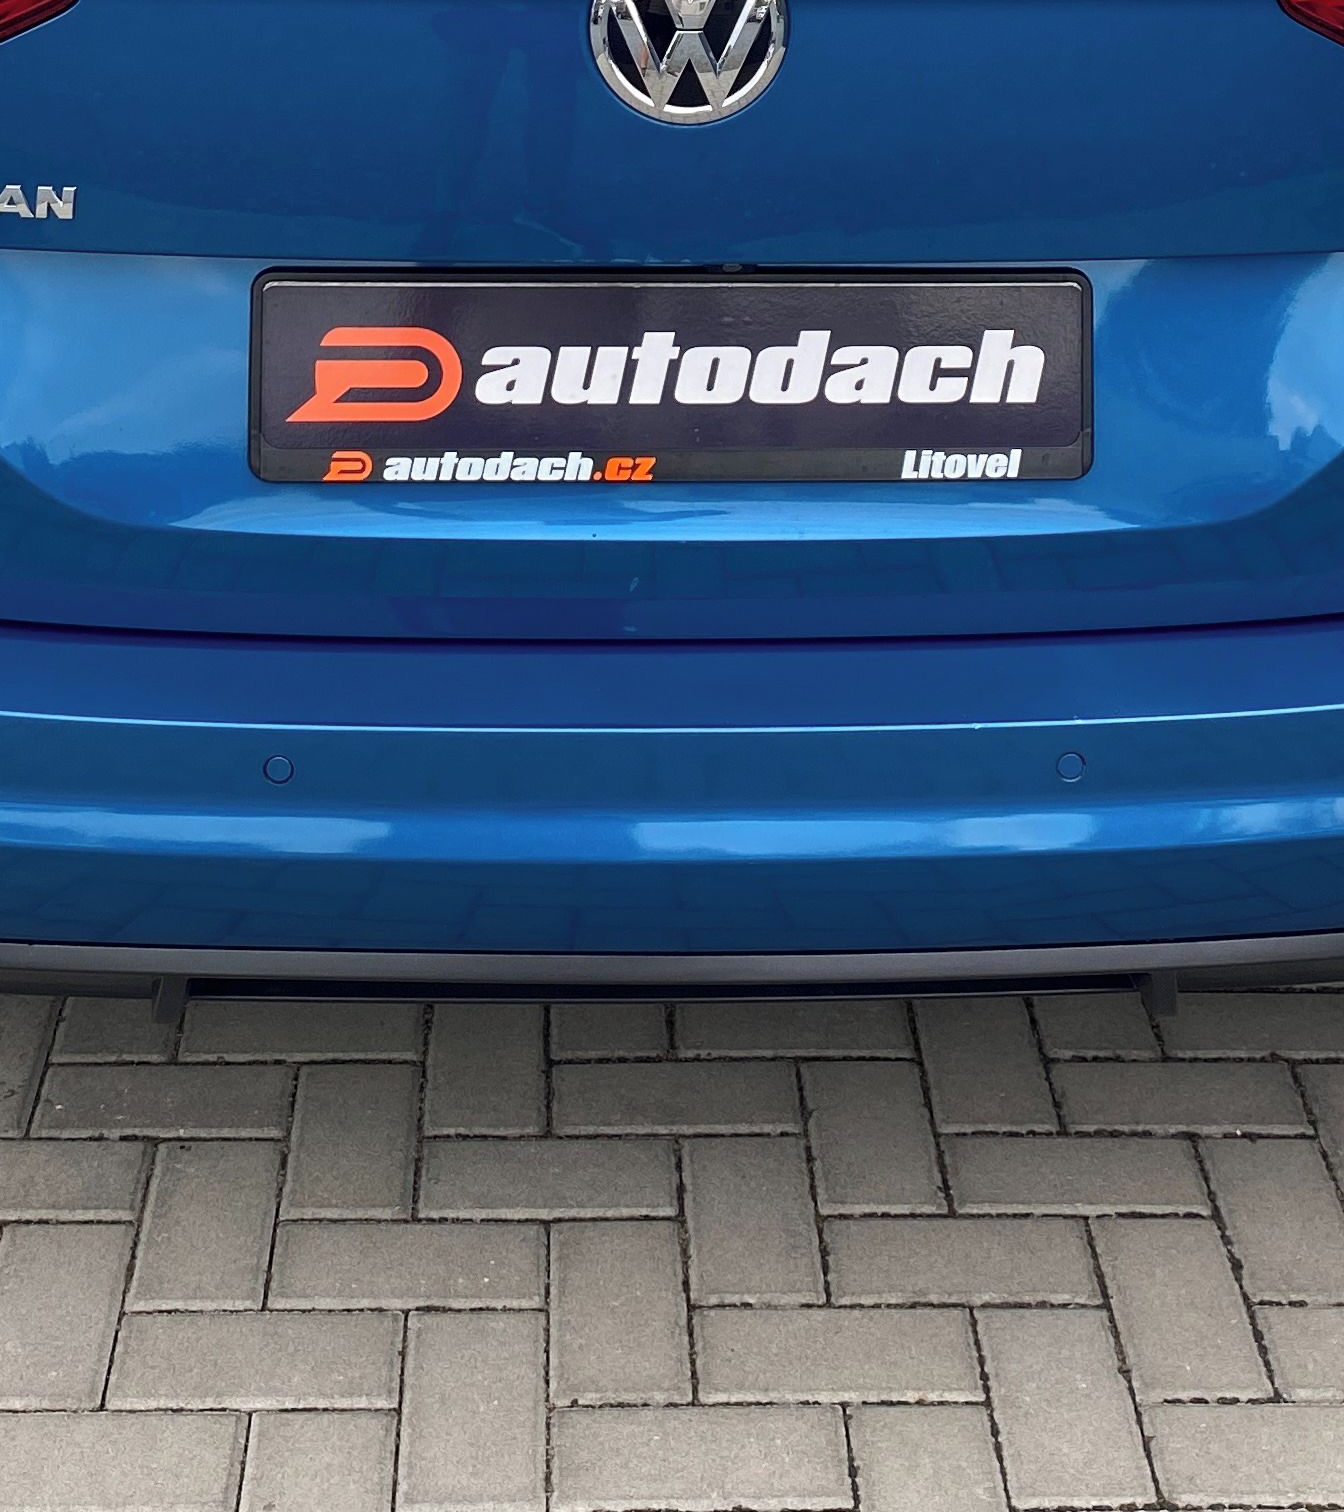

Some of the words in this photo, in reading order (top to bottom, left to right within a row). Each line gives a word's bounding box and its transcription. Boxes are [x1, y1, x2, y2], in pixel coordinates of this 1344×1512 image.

[474, 329, 1046, 405] autodach
[382, 451, 657, 481] autodach.cz
[900, 448, 1023, 479] Litovel
